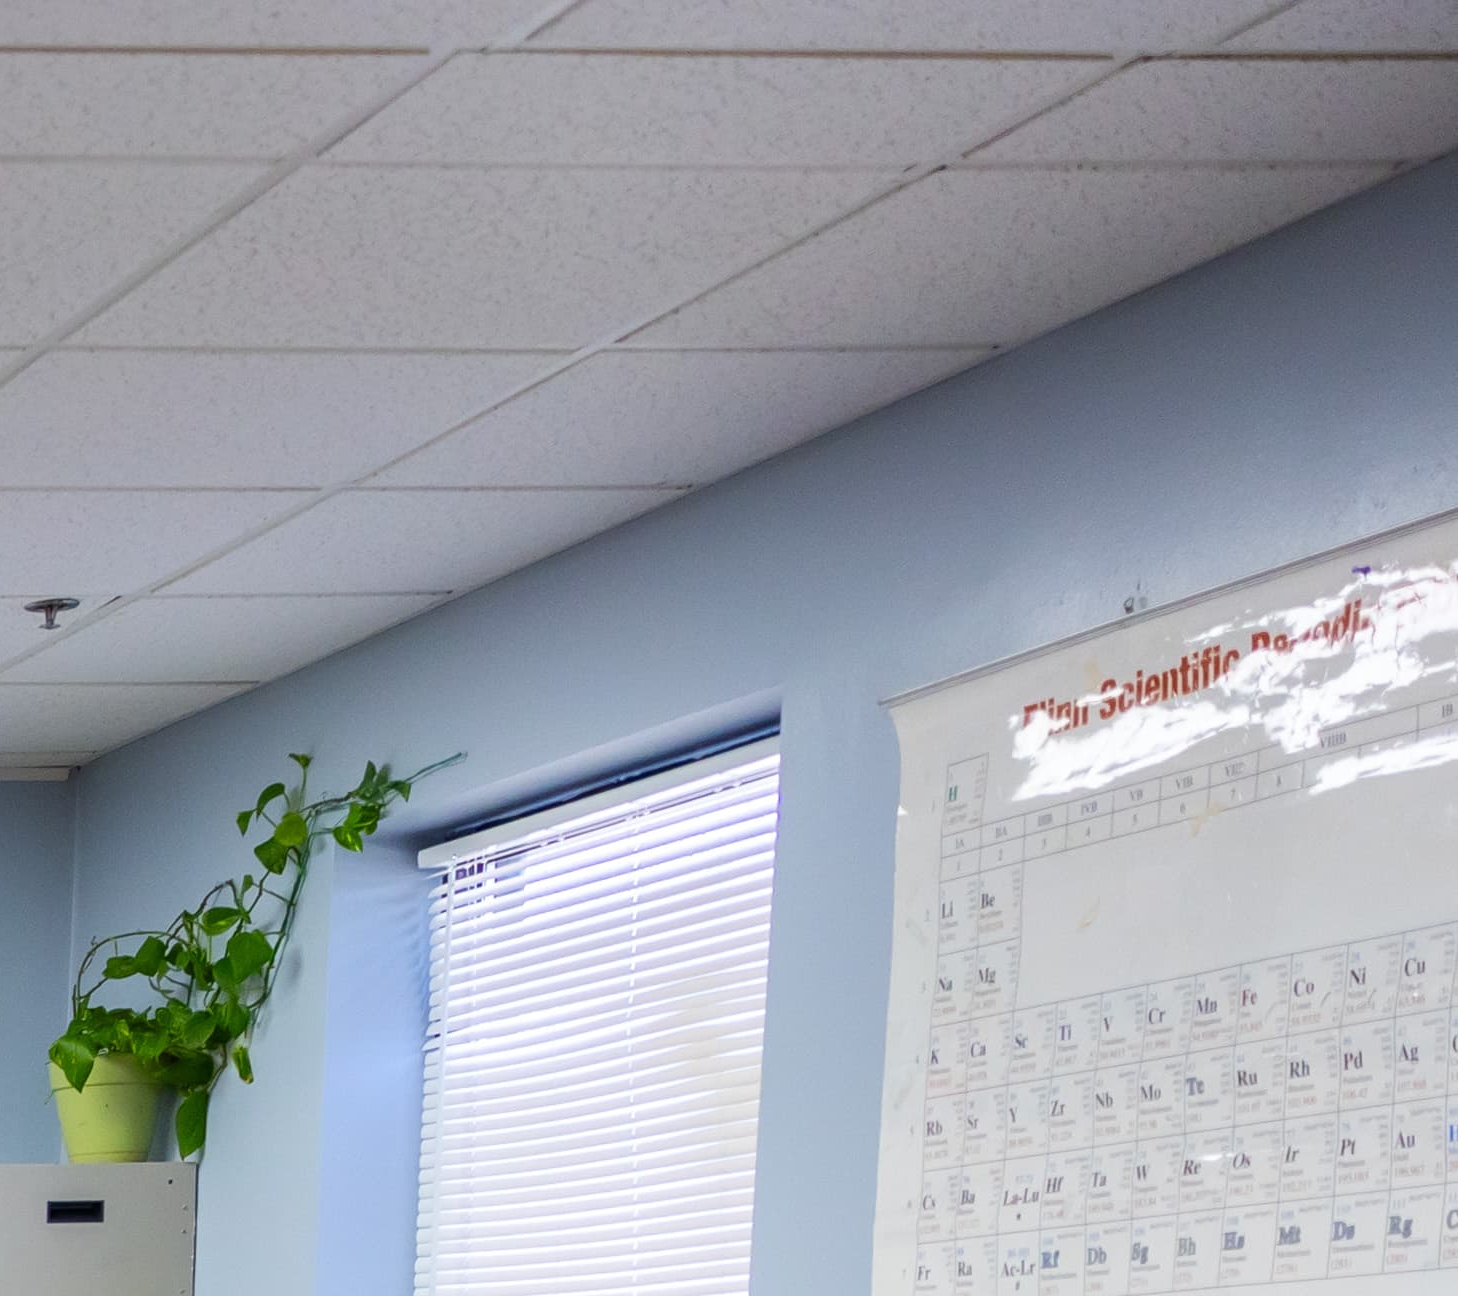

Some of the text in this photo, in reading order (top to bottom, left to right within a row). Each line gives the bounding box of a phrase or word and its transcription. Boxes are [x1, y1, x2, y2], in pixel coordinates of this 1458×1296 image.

[1099, 645, 1240, 721] Scientific
[980, 892, 995, 909] Be
[941, 901, 954, 919] Li
[978, 967, 996, 985] Mg
[1404, 957, 1426, 977] Cu
[1349, 967, 1367, 987] Ni
[1293, 978, 1315, 998] Co
[1196, 997, 1218, 1015] Mn
[1241, 989, 1258, 1008] Fe
[1103, 1016, 1114, 1033] V
[1148, 1007, 1166, 1025] Cr
[1059, 1024, 1072, 1042] Ti
[970, 1042, 986, 1058] Ca
[1398, 1043, 1420, 1063] Ag
[1289, 1060, 1310, 1080] Rh
[1343, 1051, 1363, 1071] Pd
[1237, 1069, 1258, 1088] Ru
[1095, 1092, 1113, 1110] Nb
[1139, 1084, 1162, 1102] Mo
[1050, 1100, 1065, 1117] Zr
[926, 1120, 943, 1136] Rb
[1340, 1138, 1357, 1156] Pt
[1395, 1131, 1416, 1150] Au
[1232, 1152, 1252, 1170] Os
[1284, 1146, 1300, 1164] Ir
[1182, 1159, 1202, 1176] Re
[1091, 1172, 1107, 1188] Ta
[1087, 1247, 1108, 1266] Db
